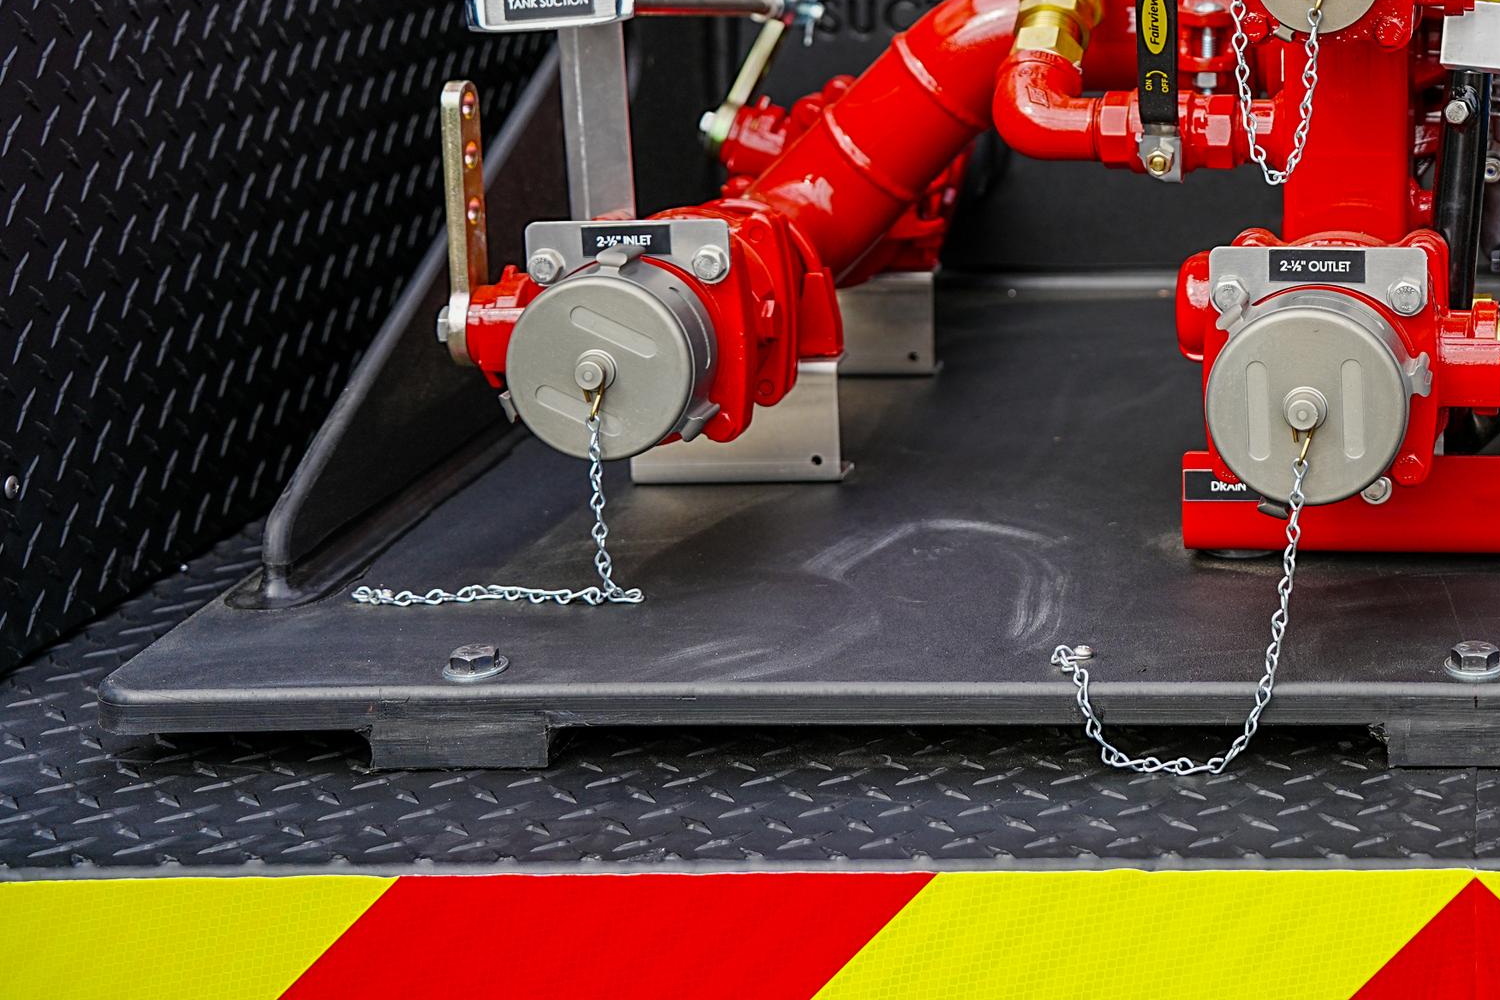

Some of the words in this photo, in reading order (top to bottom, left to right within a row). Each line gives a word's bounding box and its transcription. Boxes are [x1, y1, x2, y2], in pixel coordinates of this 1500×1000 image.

[1145, 79, 1153, 91] ON
[1161, 77, 1169, 93] OFF
[622, 234, 652, 246] INLET
[1308, 260, 1351, 272] OUTLET
[1211, 481, 1247, 492] DRAIN
